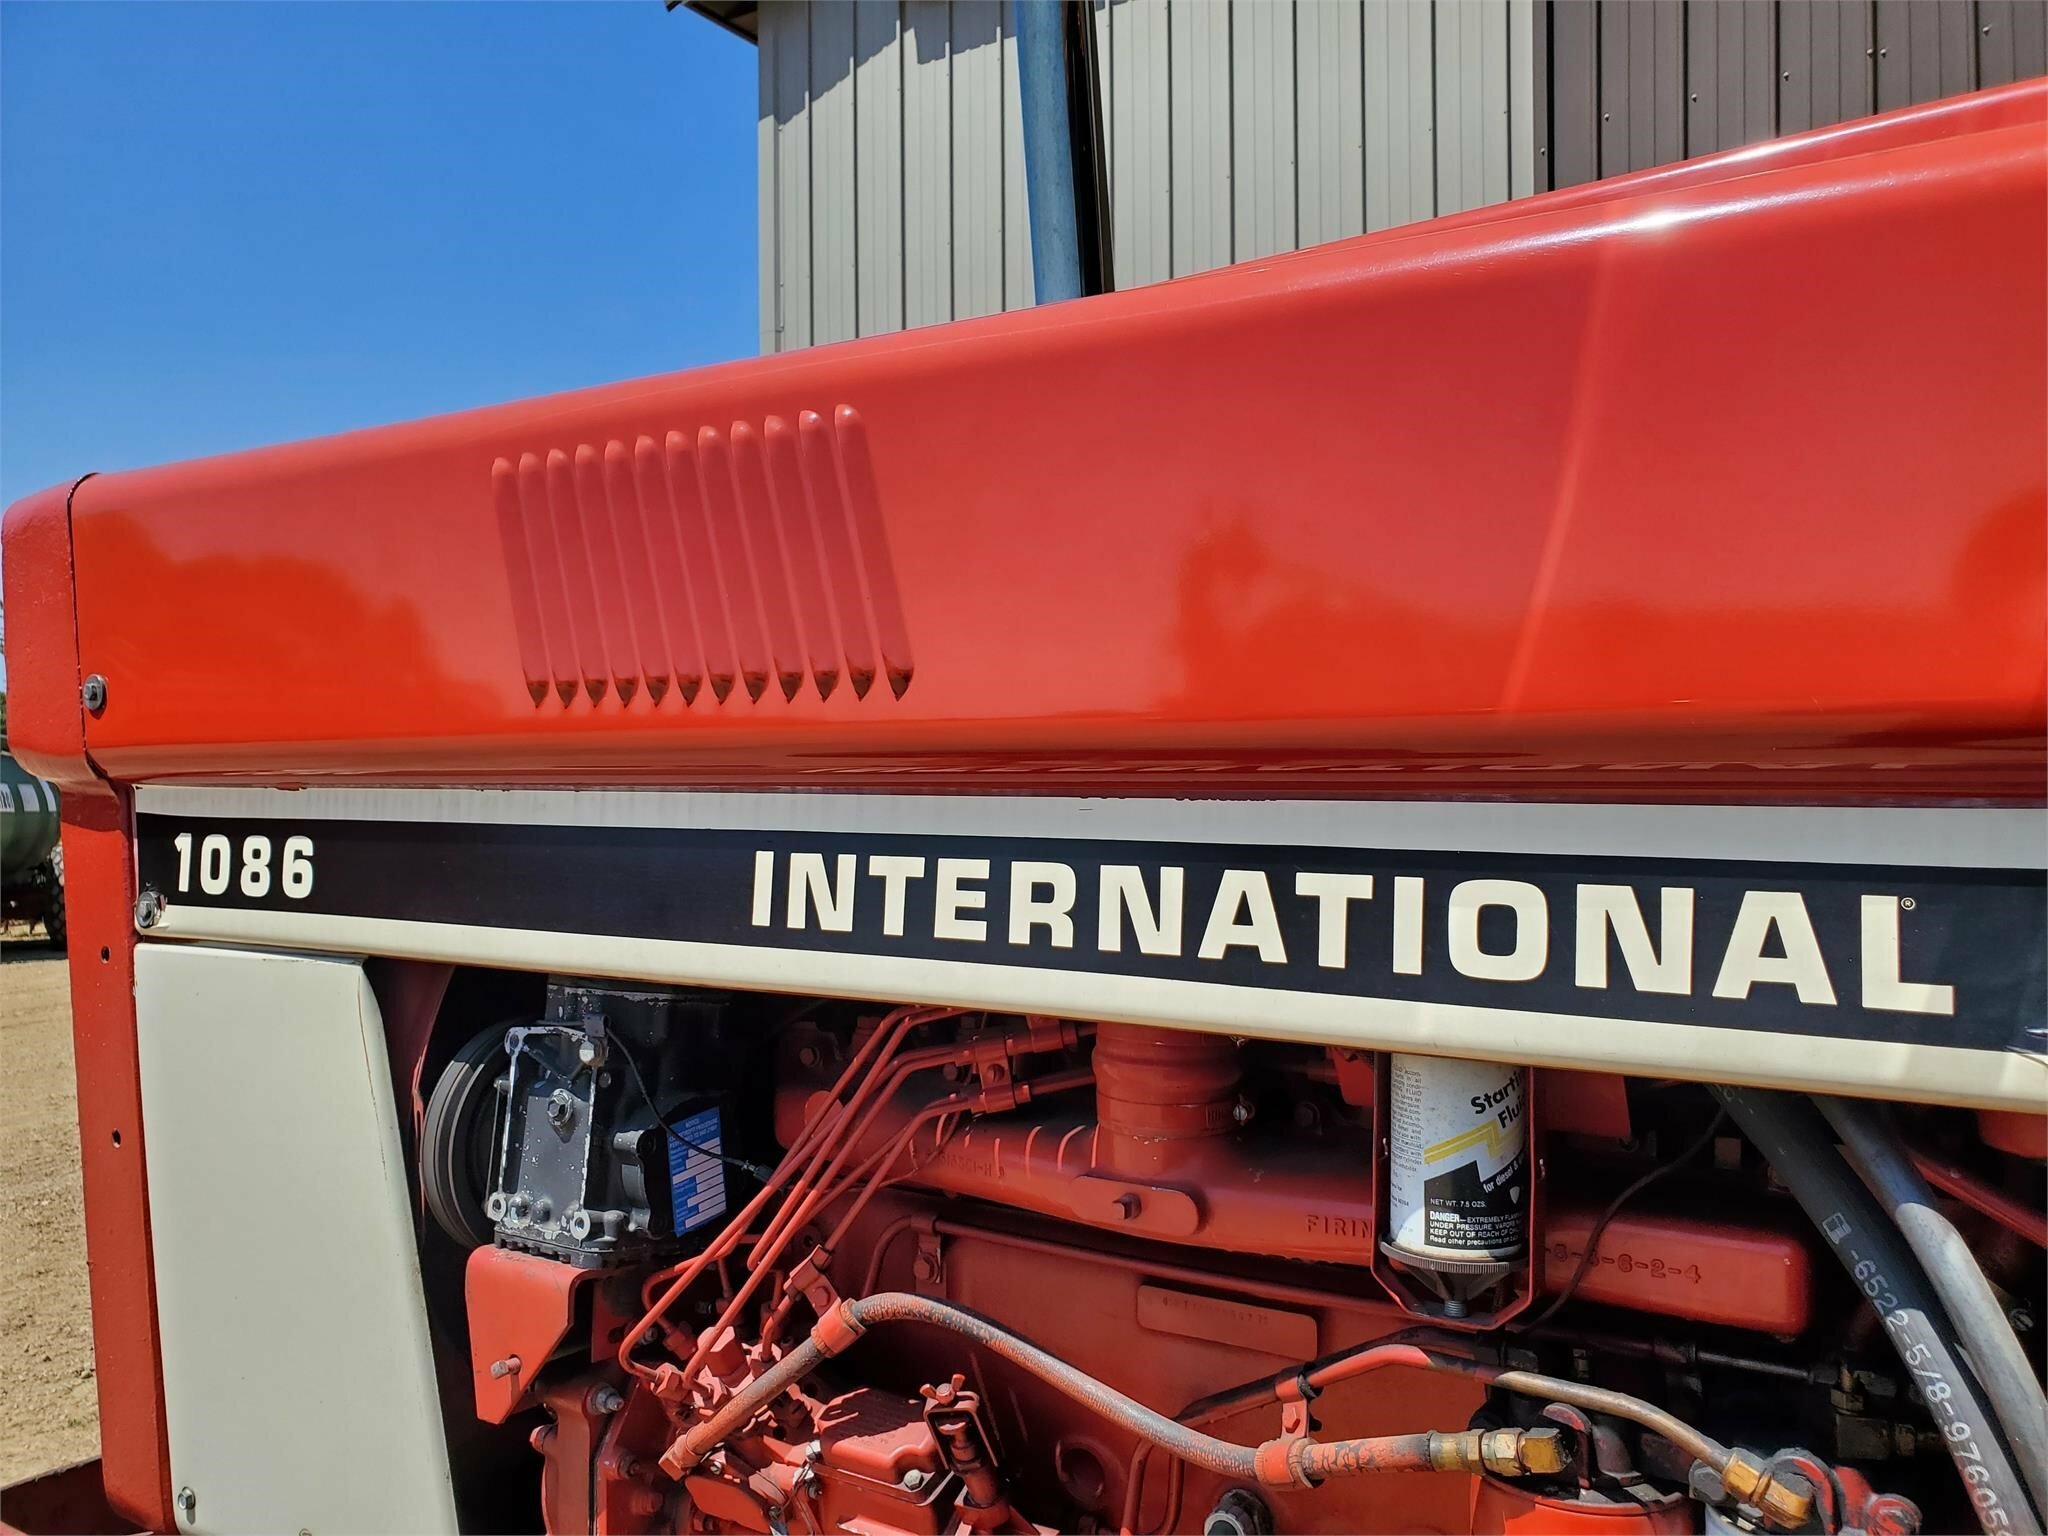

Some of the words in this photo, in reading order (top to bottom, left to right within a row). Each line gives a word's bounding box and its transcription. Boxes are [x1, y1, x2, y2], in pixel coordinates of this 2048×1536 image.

[174, 833, 314, 899] 1086
[1483, 1180, 1495, 1193] for
[1430, 1198, 1443, 1206] NET
[1460, 1200, 1470, 1208] 7.5
[1306, 1214, 1373, 1239] FIRIN
[1429, 1221, 1454, 1230] UNDER
[1429, 1228, 1448, 1236] KEEP
[1477, 1230, 1500, 1238] REACH
[1429, 1235, 1446, 1243] Read
[1466, 1237, 1502, 1246] precautions
[1850, 1249, 2012, 1536] -6522-5/8-97605
